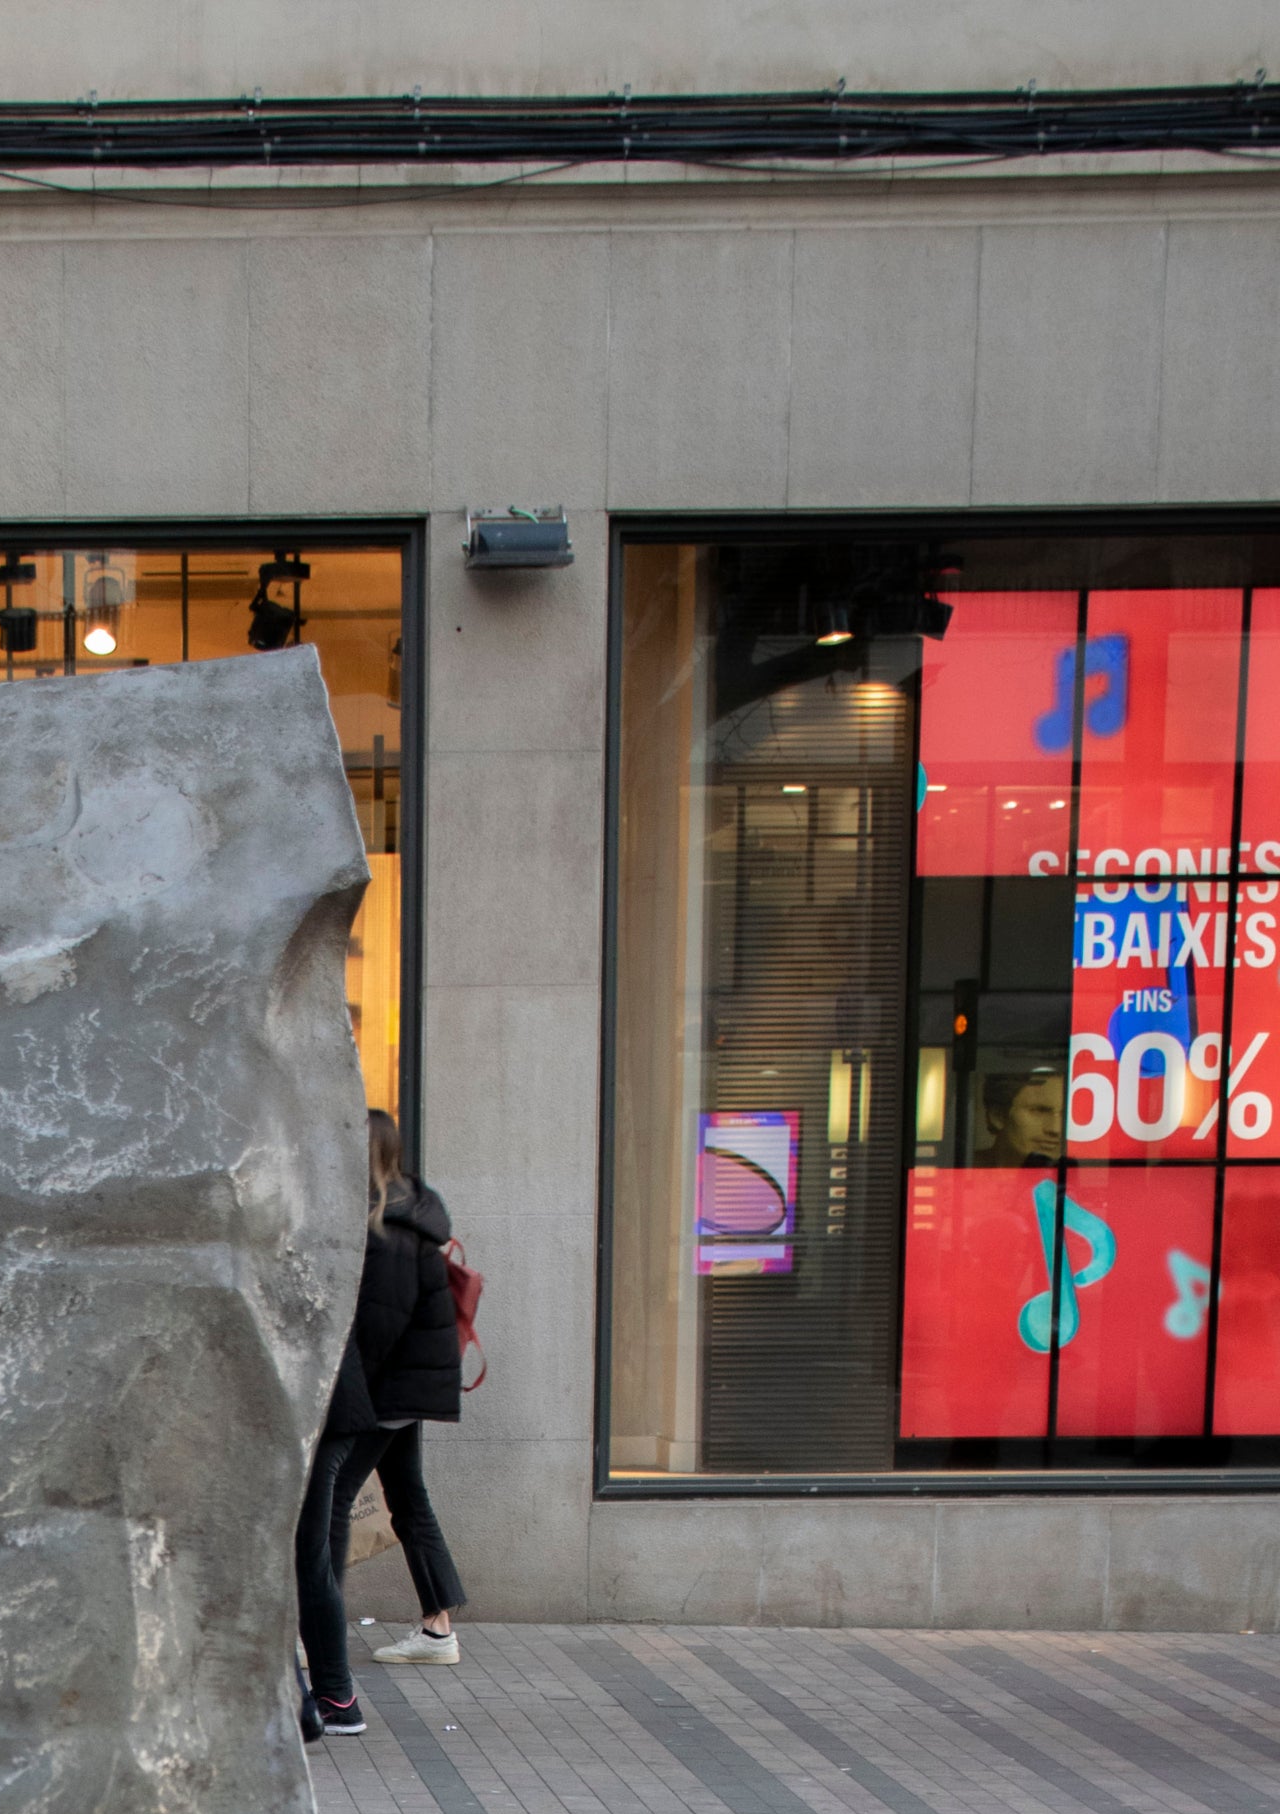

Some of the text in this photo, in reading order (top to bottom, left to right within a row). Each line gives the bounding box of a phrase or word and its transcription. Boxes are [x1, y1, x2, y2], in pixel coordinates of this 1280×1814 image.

[1073, 912, 1278, 968] BAIXES
[1122, 990, 1173, 1013] FINS
[1066, 1032, 1273, 1142] 60%
[358, 1493, 375, 1506] ARE
